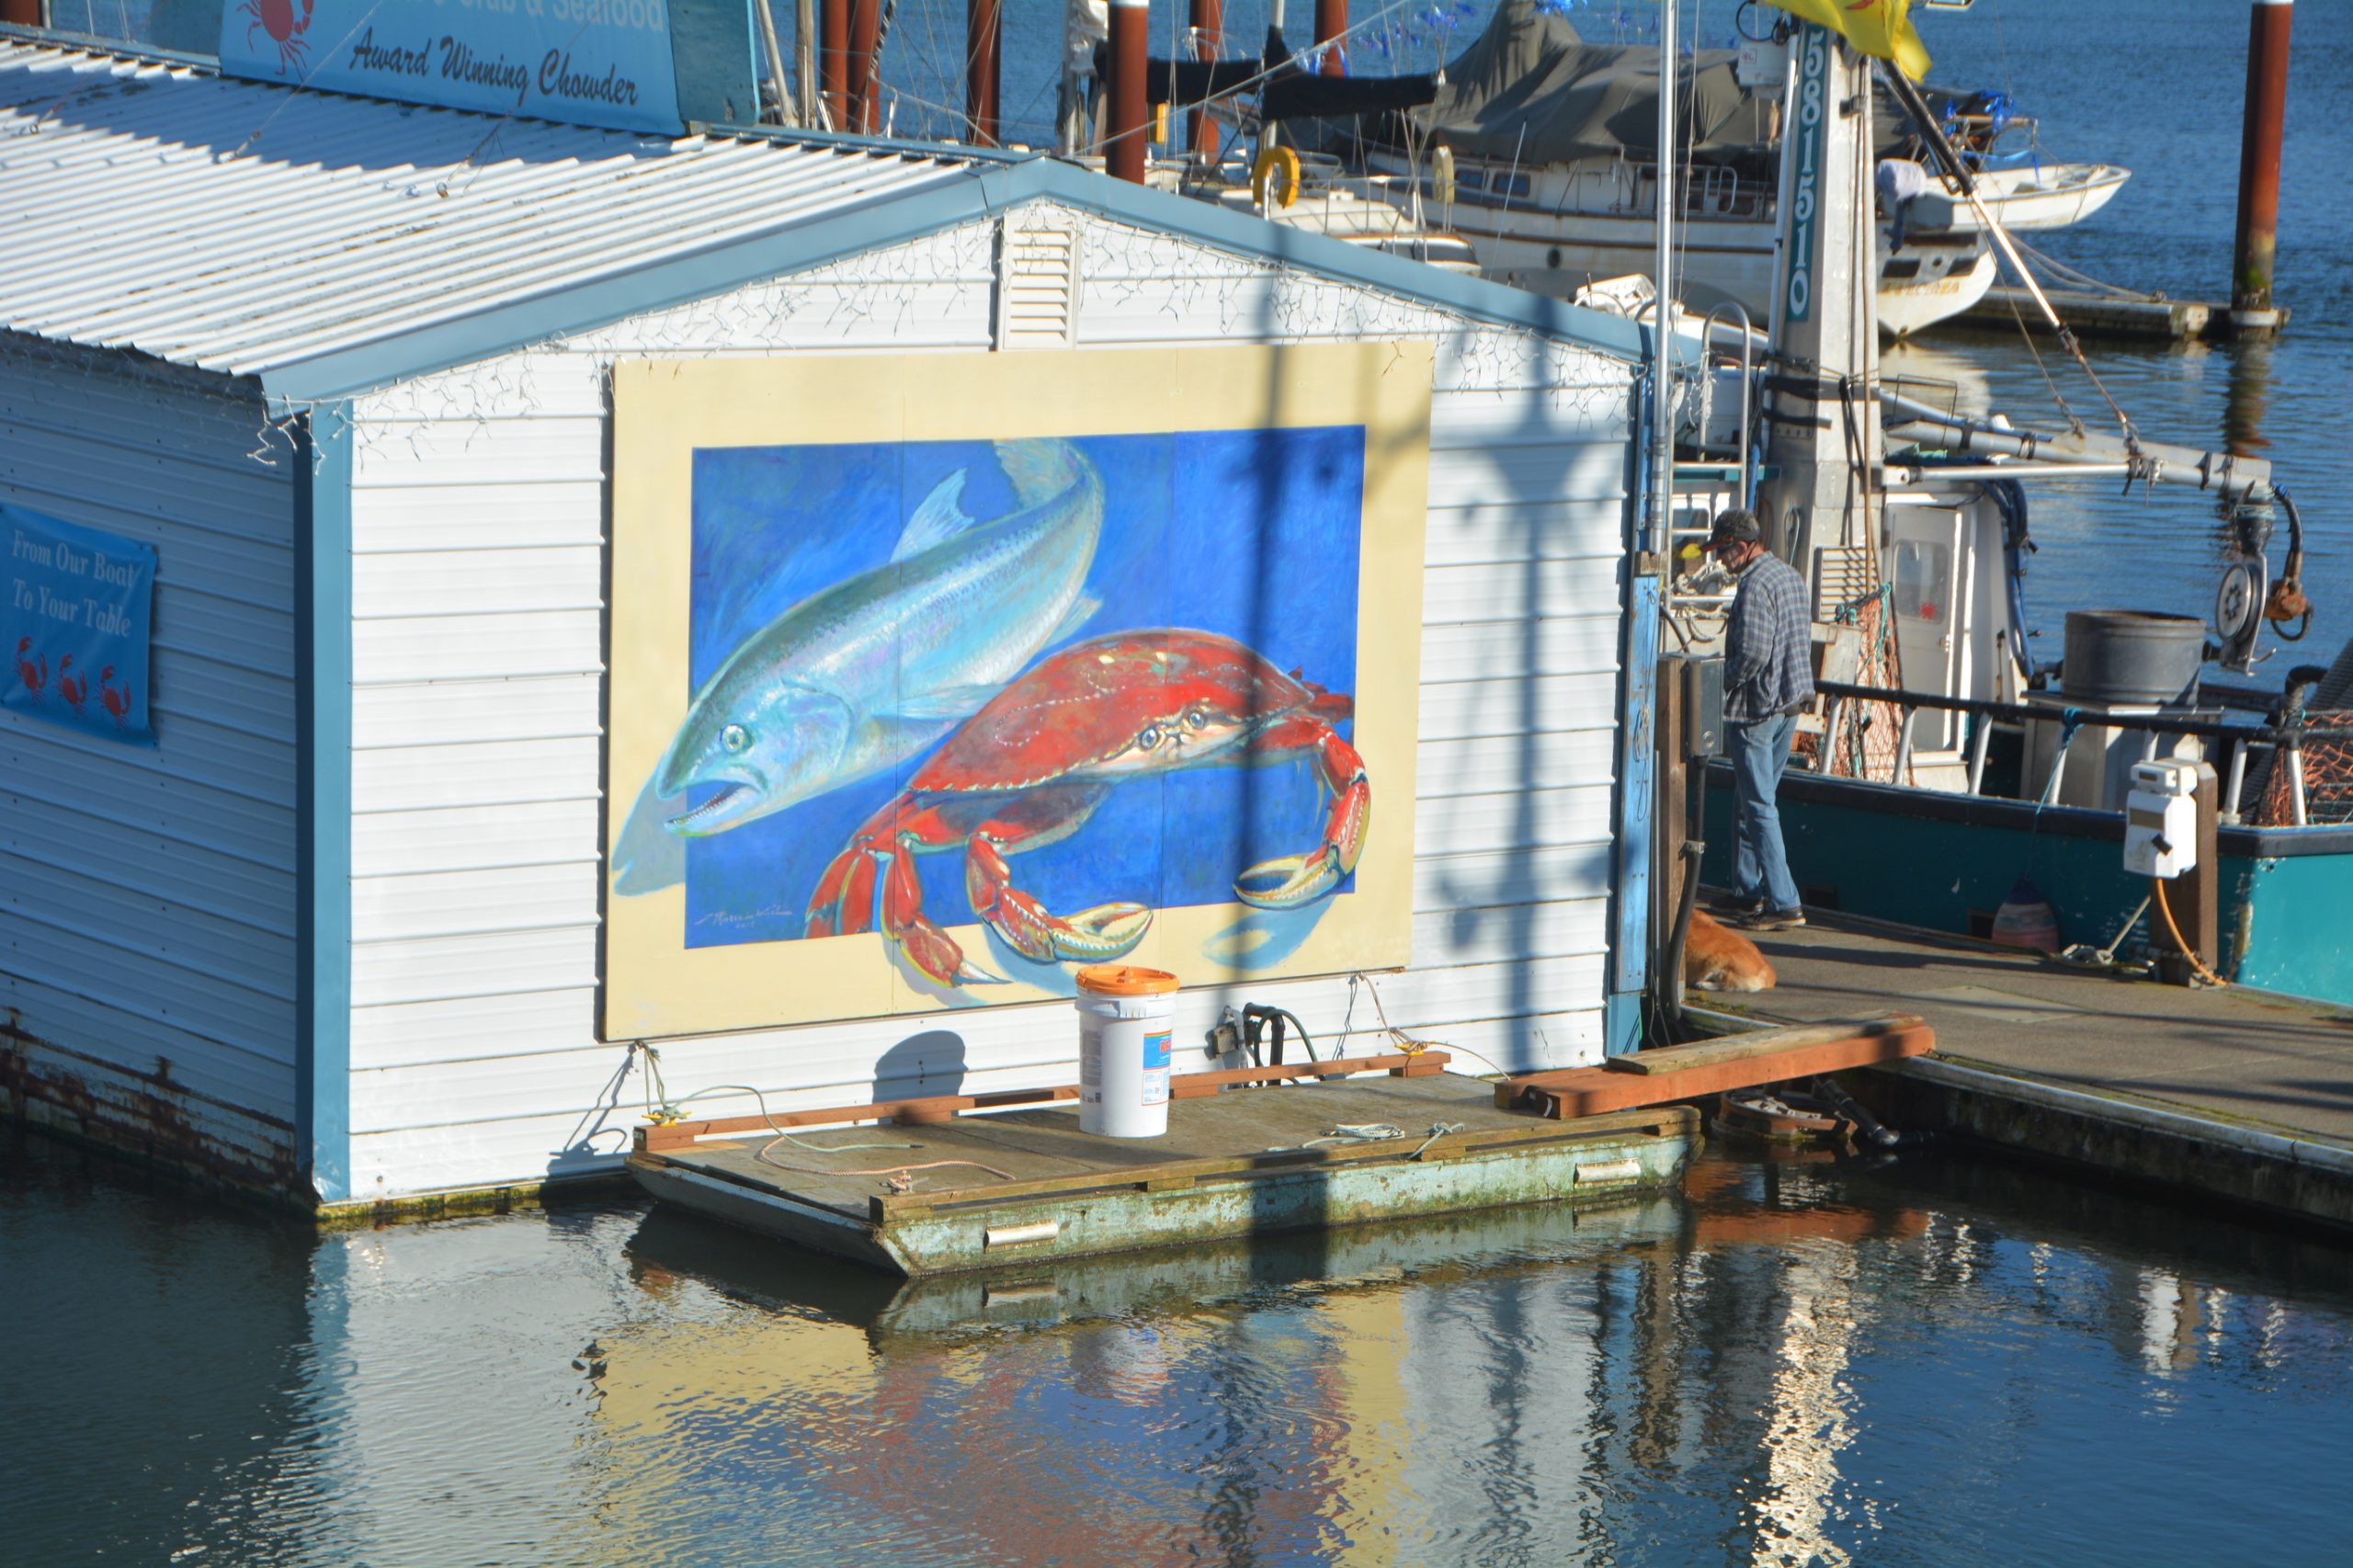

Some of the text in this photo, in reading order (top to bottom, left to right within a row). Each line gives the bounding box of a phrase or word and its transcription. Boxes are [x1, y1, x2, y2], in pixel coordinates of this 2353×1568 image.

[348, 26, 639, 107] Award Winning Chowder
[1789, 28, 1824, 316] 581510
[12, 529, 135, 588] From Our Boat
[13, 578, 131, 638] To Your Table
